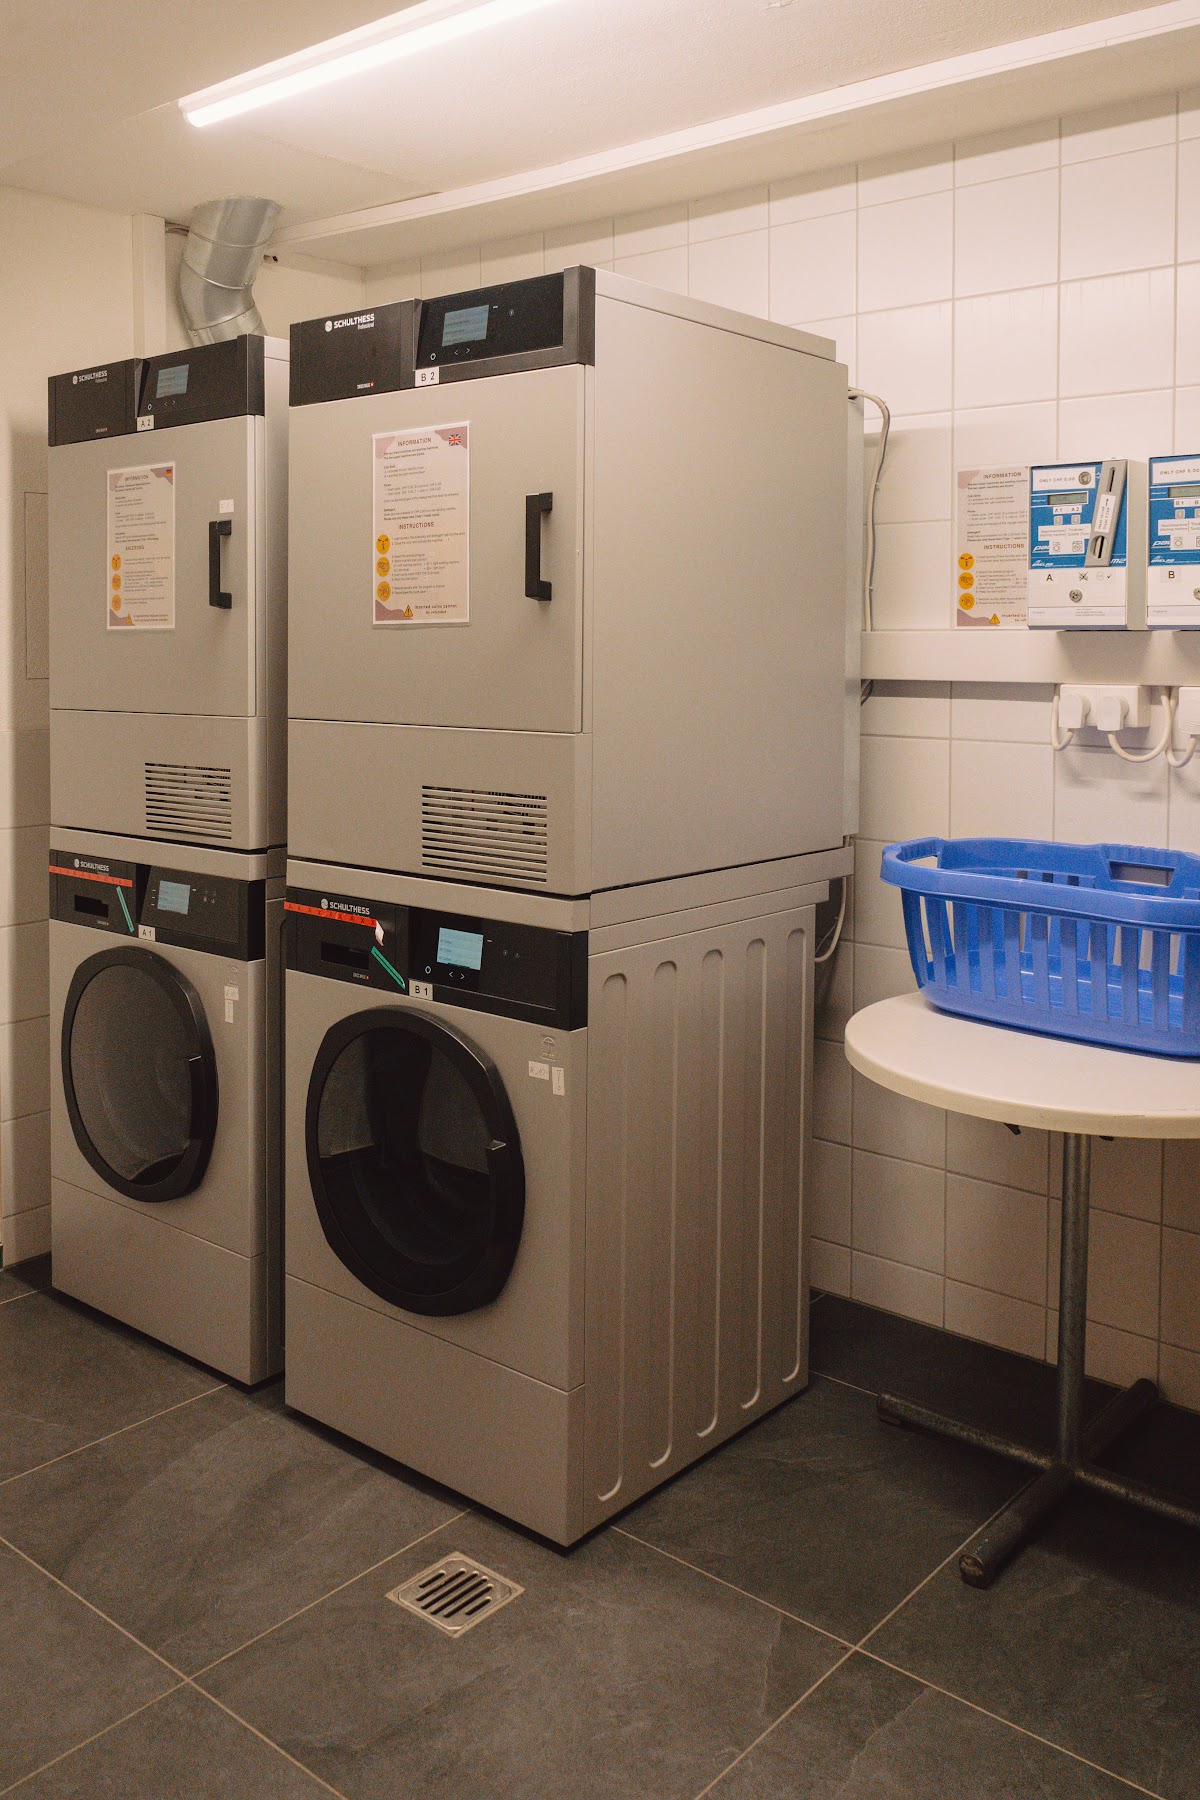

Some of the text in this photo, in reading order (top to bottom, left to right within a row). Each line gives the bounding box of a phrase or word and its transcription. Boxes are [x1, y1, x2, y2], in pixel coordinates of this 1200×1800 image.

[334, 314, 374, 329] SCHULTHESS
[79, 370, 108, 382] SCHULTHESS
[430, 372, 435, 380] 2
[398, 438, 431, 447] INFORMATION
[80, 861, 109, 872] SCHULTHESS
[330, 902, 370, 915] SCHULTHESS
